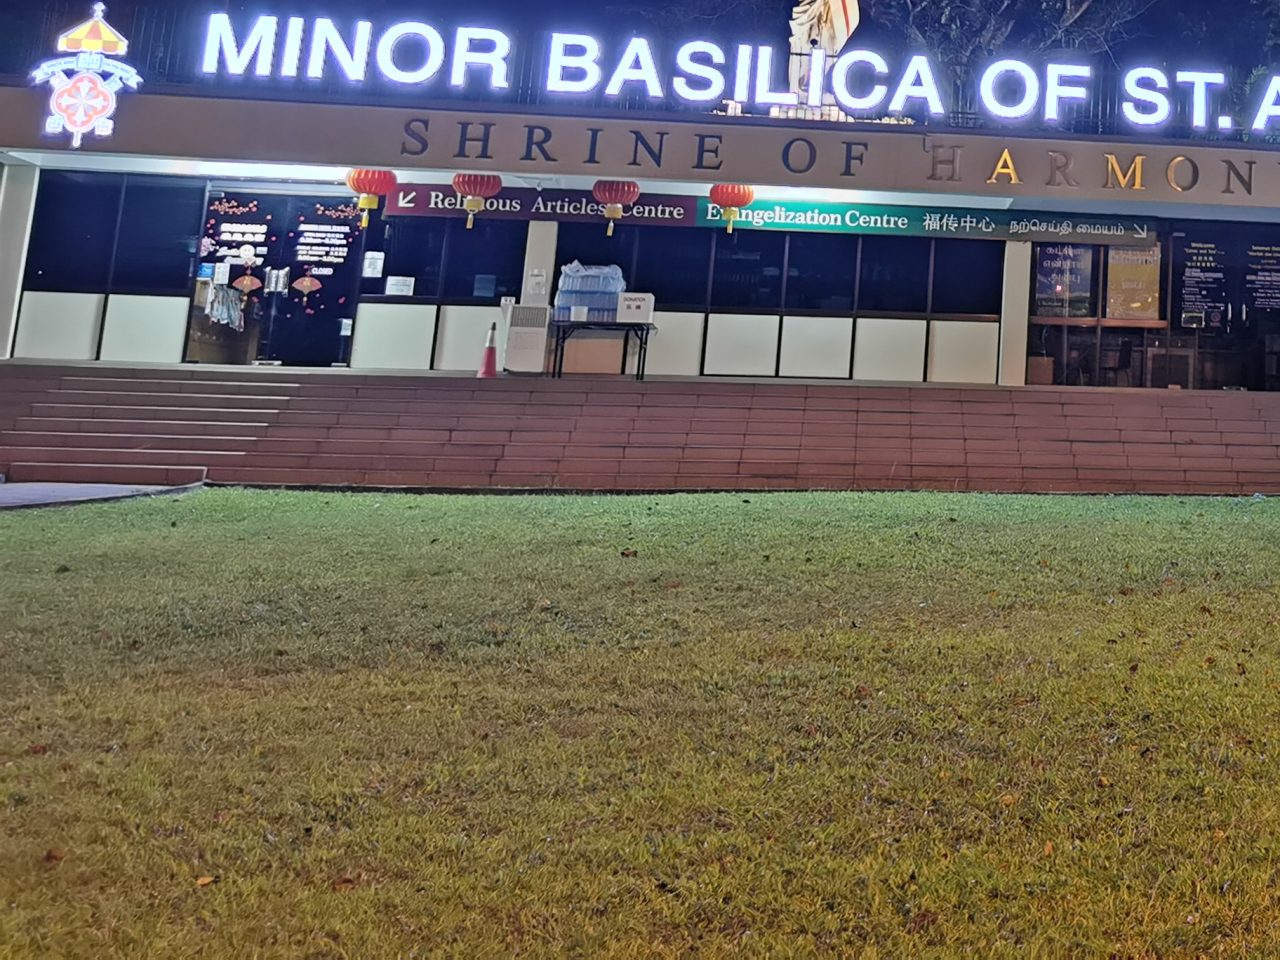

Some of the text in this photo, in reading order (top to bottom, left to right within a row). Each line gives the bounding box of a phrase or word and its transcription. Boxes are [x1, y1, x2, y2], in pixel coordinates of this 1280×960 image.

[201, 13, 511, 89] MINOR
[546, 33, 945, 114] BASILICA
[980, 58, 1092, 121] OF
[1122, 66, 1232, 129] ST.
[401, 118, 724, 171] SHRINE
[782, 137, 869, 177] OF
[845, 209, 908, 228] Centre
[922, 212, 995, 232] 福传中心
[1009, 218, 1125, 236] நற்செய்தி மையம்
